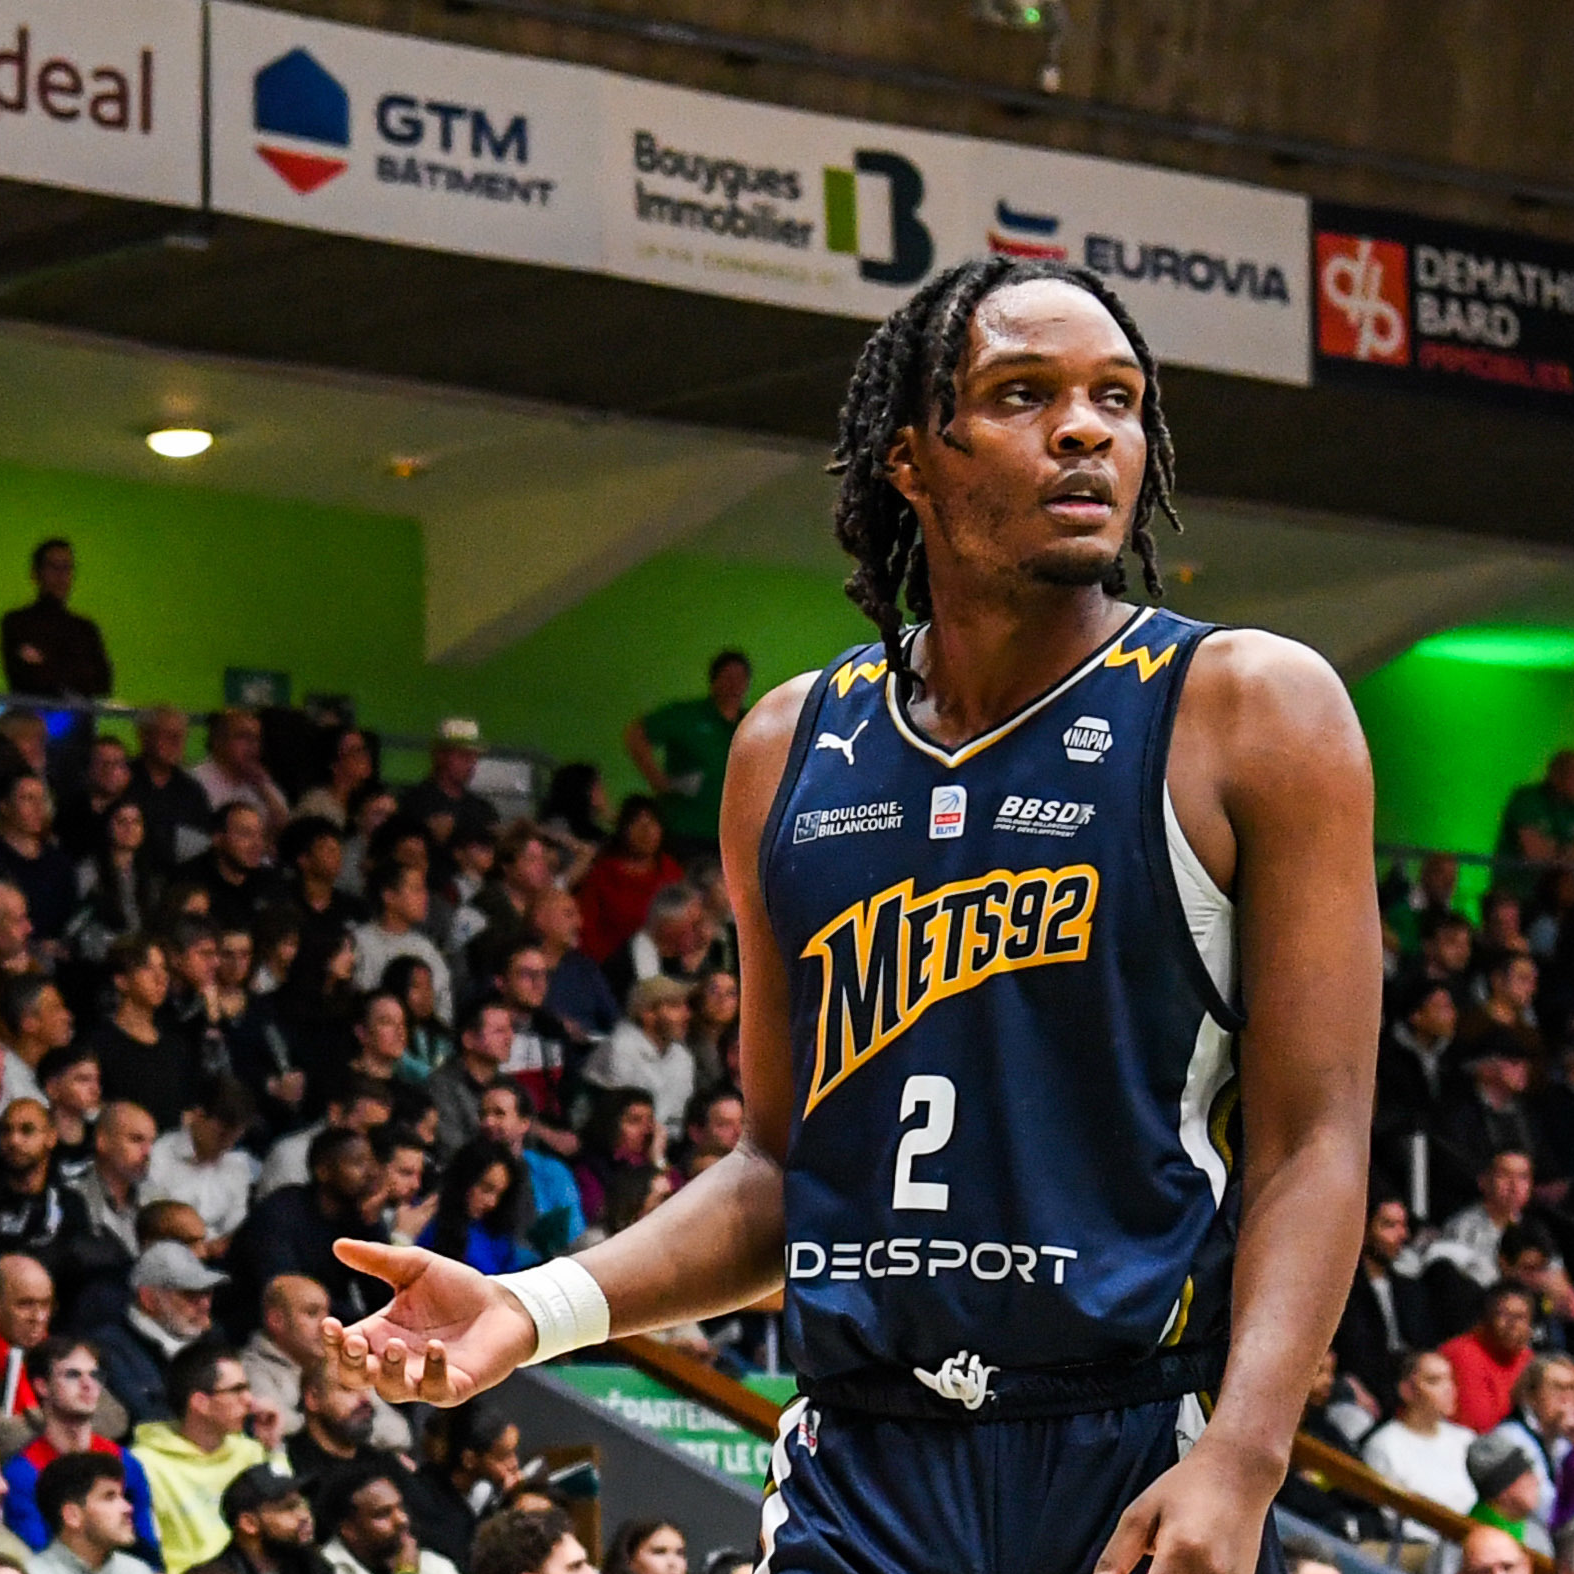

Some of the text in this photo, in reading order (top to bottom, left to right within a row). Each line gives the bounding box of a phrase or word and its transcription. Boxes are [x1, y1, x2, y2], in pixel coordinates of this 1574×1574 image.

[376, 91, 529, 165] GTM
[633, 128, 801, 201] Bouygues
[635, 178, 814, 249] Immobilier
[1084, 231, 1291, 307] EUROVIA
[1417, 291, 1521, 348] BARD
[1068, 727, 1107, 751] NAPA
[818, 815, 904, 837] BILLANCOURT
[820, 801, 903, 823] BOULOGNE-
[998, 796, 1080, 823] BBSD
[892, 1075, 956, 1212] 2
